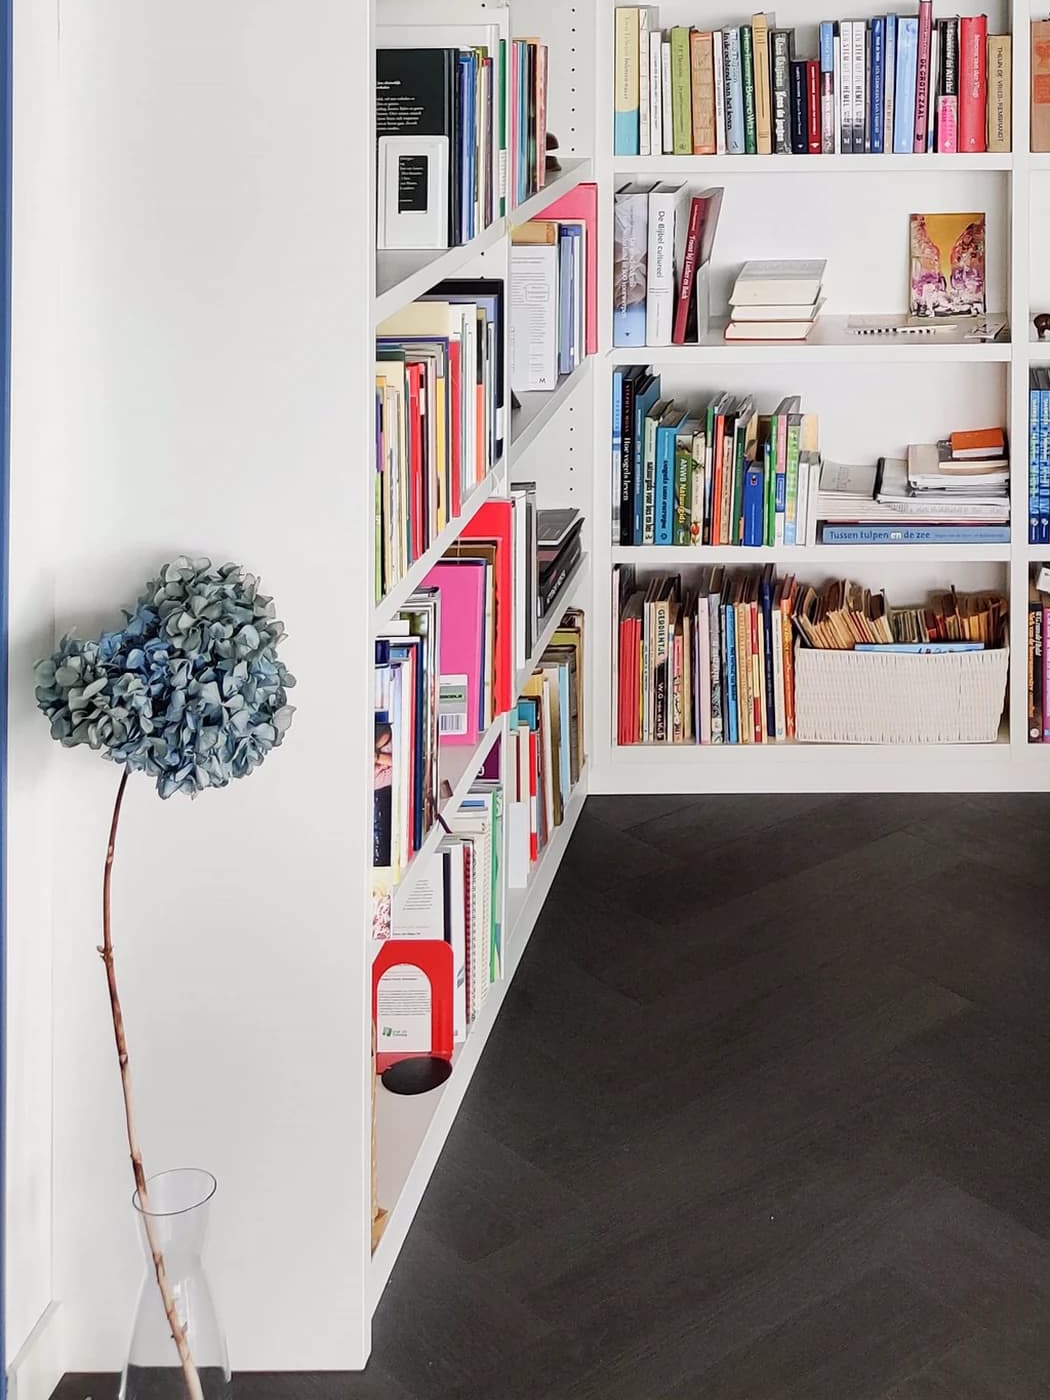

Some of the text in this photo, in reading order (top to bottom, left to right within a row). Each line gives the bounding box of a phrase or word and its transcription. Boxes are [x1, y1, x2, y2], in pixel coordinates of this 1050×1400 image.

[920, 58, 926, 69] DE
[918, 70, 926, 97] GROTE
[658, 210, 665, 222] De
[656, 223, 665, 244] Bijbel
[623, 437, 631, 450] Hoe
[622, 450, 630, 480] vogels
[622, 480, 630, 502] leven
[677, 484, 686, 524] Natuurgids
[829, 530, 931, 542] Tussen tulpen en de zee
